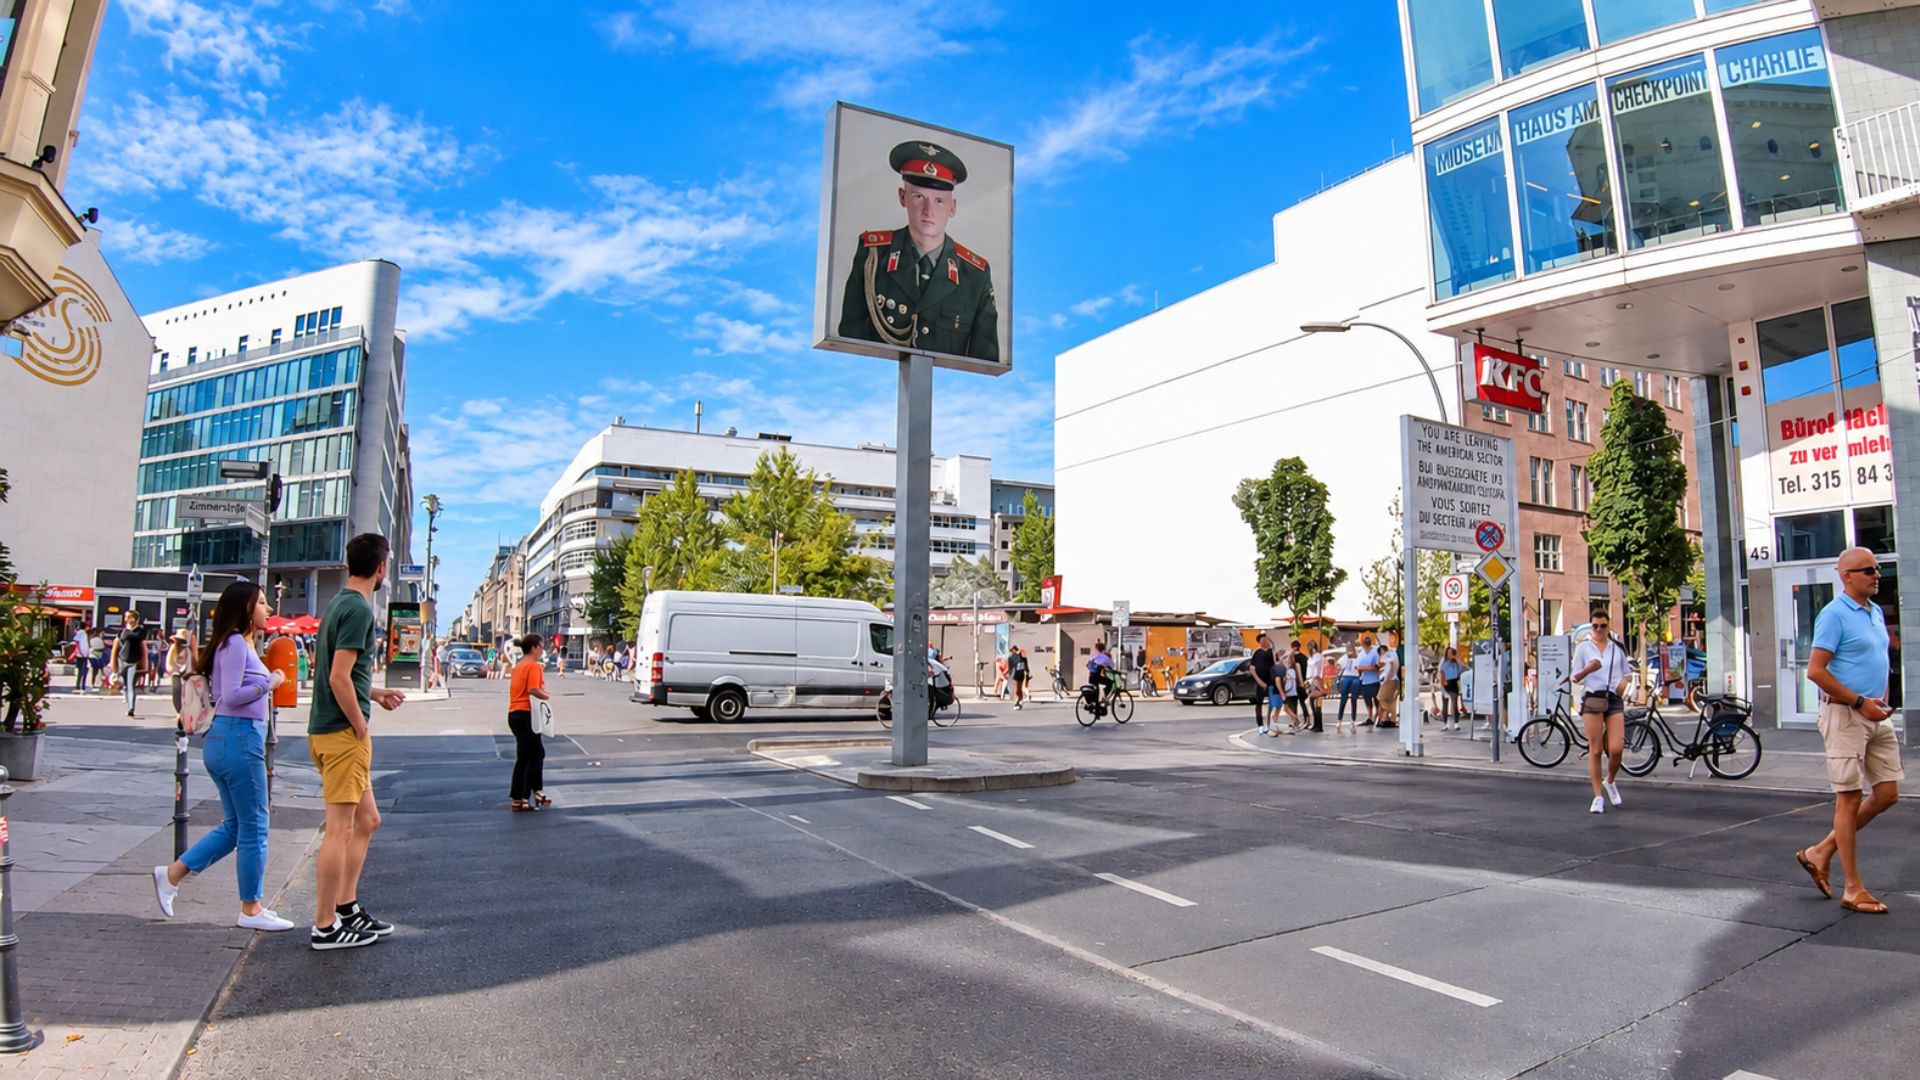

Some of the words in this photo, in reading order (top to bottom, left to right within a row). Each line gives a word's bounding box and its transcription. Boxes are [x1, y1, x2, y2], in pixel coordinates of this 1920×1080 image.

[1520, 108, 1566, 142] HAUS
[1571, 101, 1600, 124] AM
[1727, 46, 1818, 83] CHARLIE
[1480, 355, 1543, 398] KFC
[1421, 424, 1439, 439] YOU
[1444, 430, 1460, 444] ARE
[1465, 434, 1498, 451] LEAVING
[1417, 440, 1431, 453] THE
[1477, 451, 1504, 467] SECTOR
[1789, 449, 1808, 465] zu
[1778, 475, 1806, 494] Tel.
[1811, 469, 1841, 490] 315
[1857, 465, 1878, 485] 84
[1419, 511, 1431, 523] DU
[1433, 513, 1466, 528] SECTEUR
[1431, 496, 1456, 511] VOUS
[1460, 501, 1491, 516] SORTEZ
[1750, 546, 1770, 561] 45
